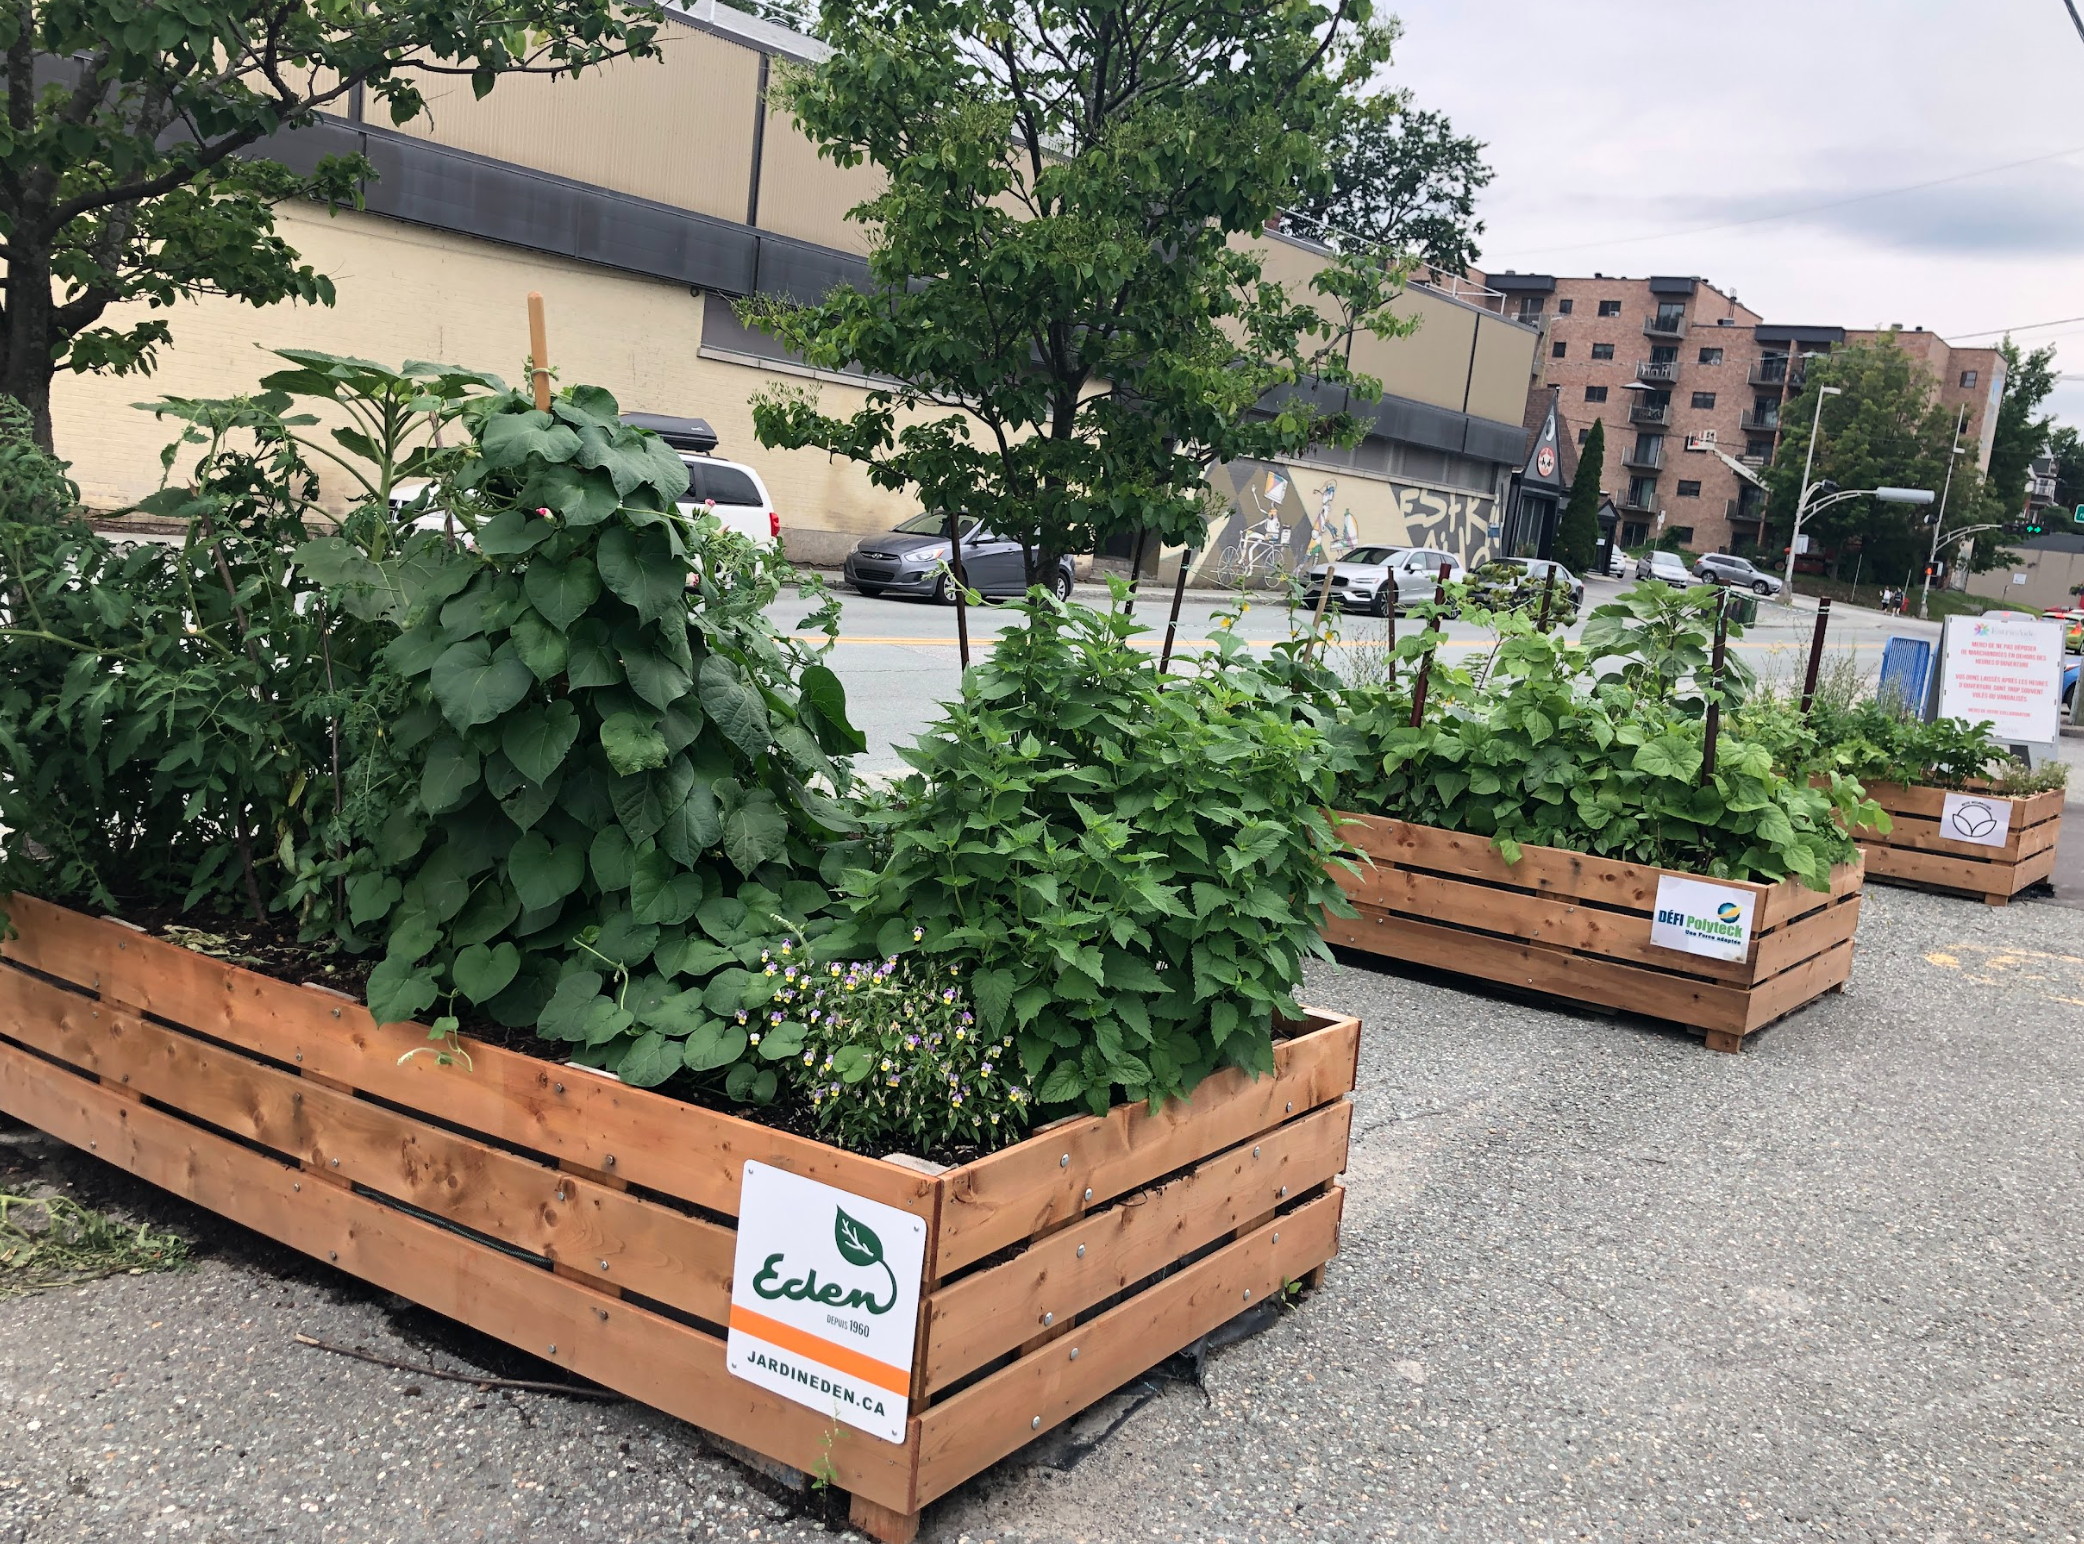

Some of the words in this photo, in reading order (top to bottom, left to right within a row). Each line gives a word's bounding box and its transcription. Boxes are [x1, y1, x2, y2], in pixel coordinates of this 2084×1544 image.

[2021, 687, 2043, 695] SOUVENT
[1658, 910, 1684, 926] DÉFI
[1686, 915, 1743, 938] Polyteck
[1699, 932, 1715, 940] Force
[1717, 936, 1741, 945] adaptée
[752, 1253, 898, 1314] Eden
[826, 1314, 848, 1330] DEPUIS
[849, 1320, 870, 1338] 1960
[747, 1350, 886, 1416] JARDINEDEN.CA
